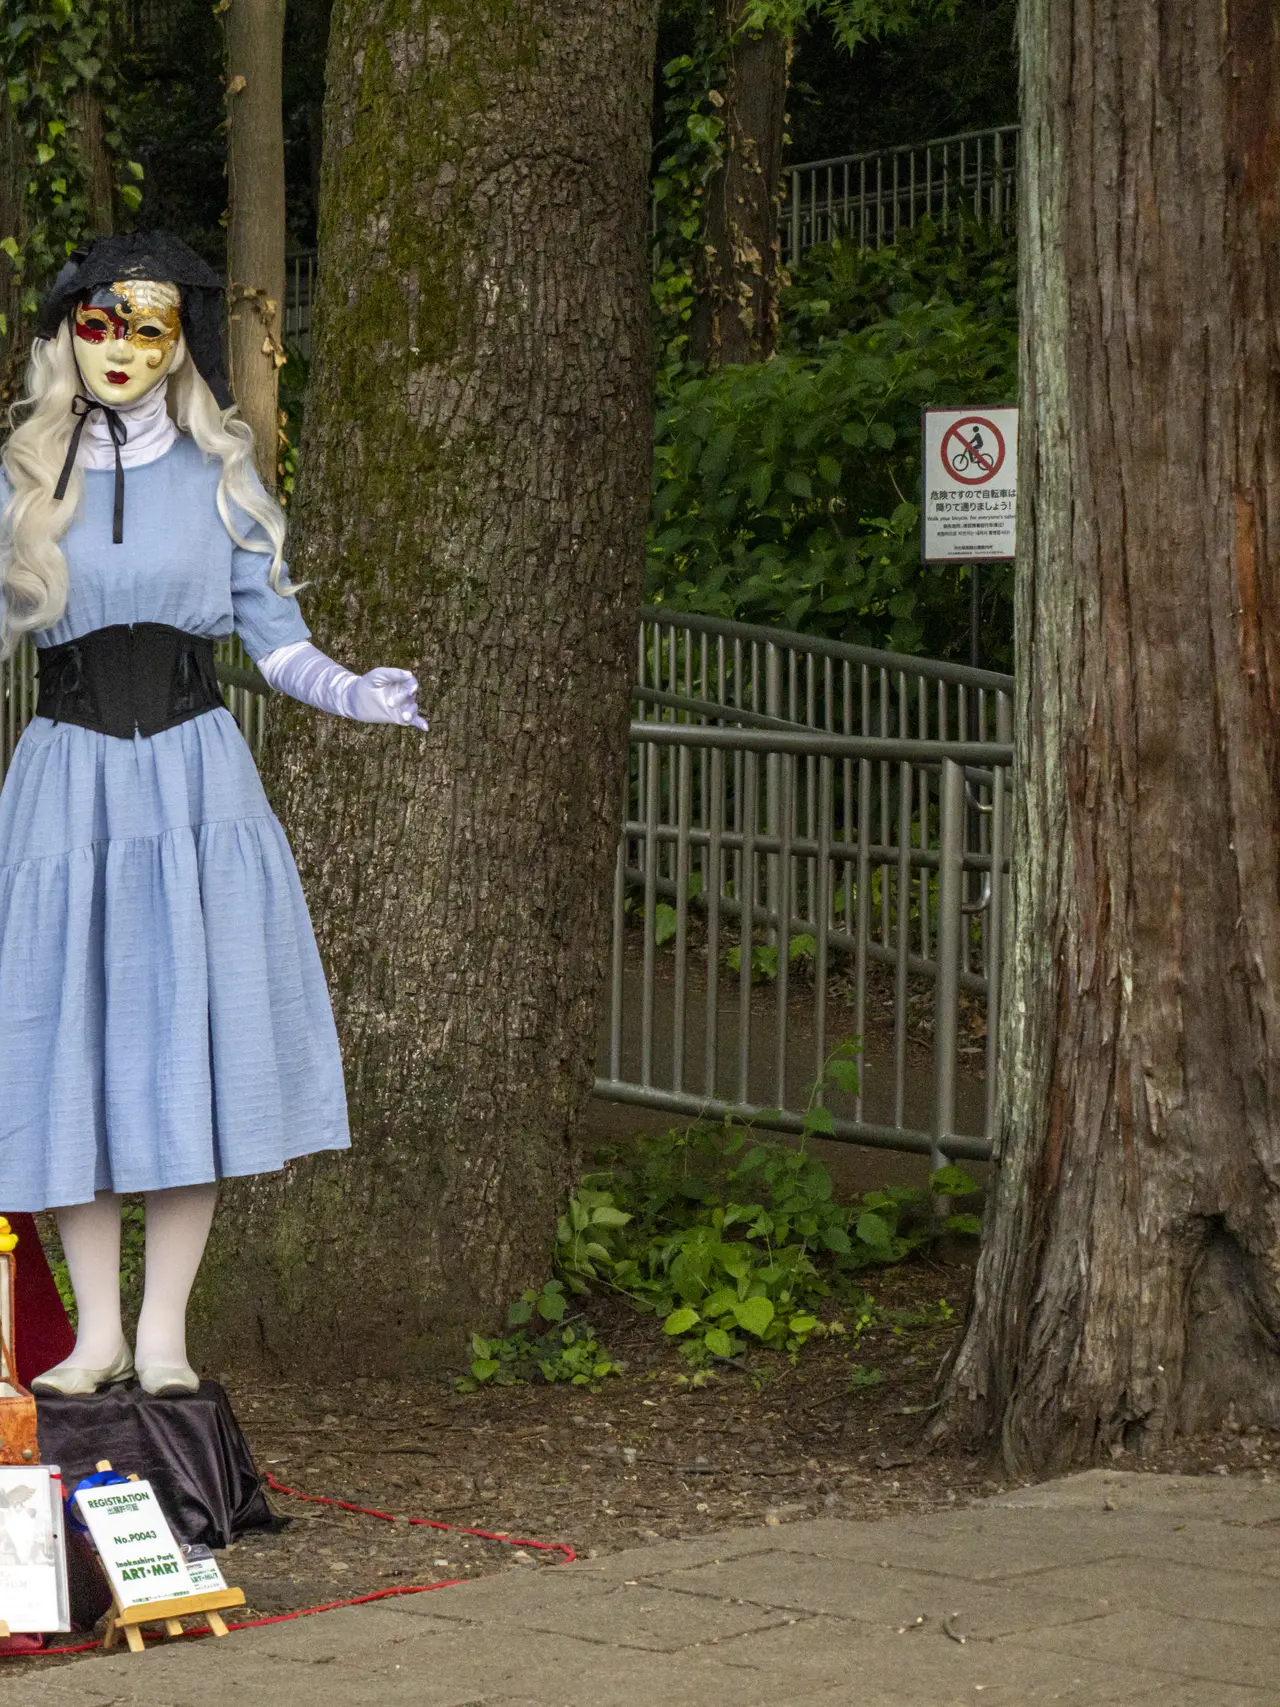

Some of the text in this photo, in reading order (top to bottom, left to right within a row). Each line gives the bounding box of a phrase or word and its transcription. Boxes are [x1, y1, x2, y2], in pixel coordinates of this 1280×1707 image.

[930, 489, 1016, 500] 危険ですので自転車は
[87, 1492, 150, 1508] REGISTRATION
[113, 1530, 157, 1545] No.P0043
[115, 1553, 175, 1568] Inokashira Park
